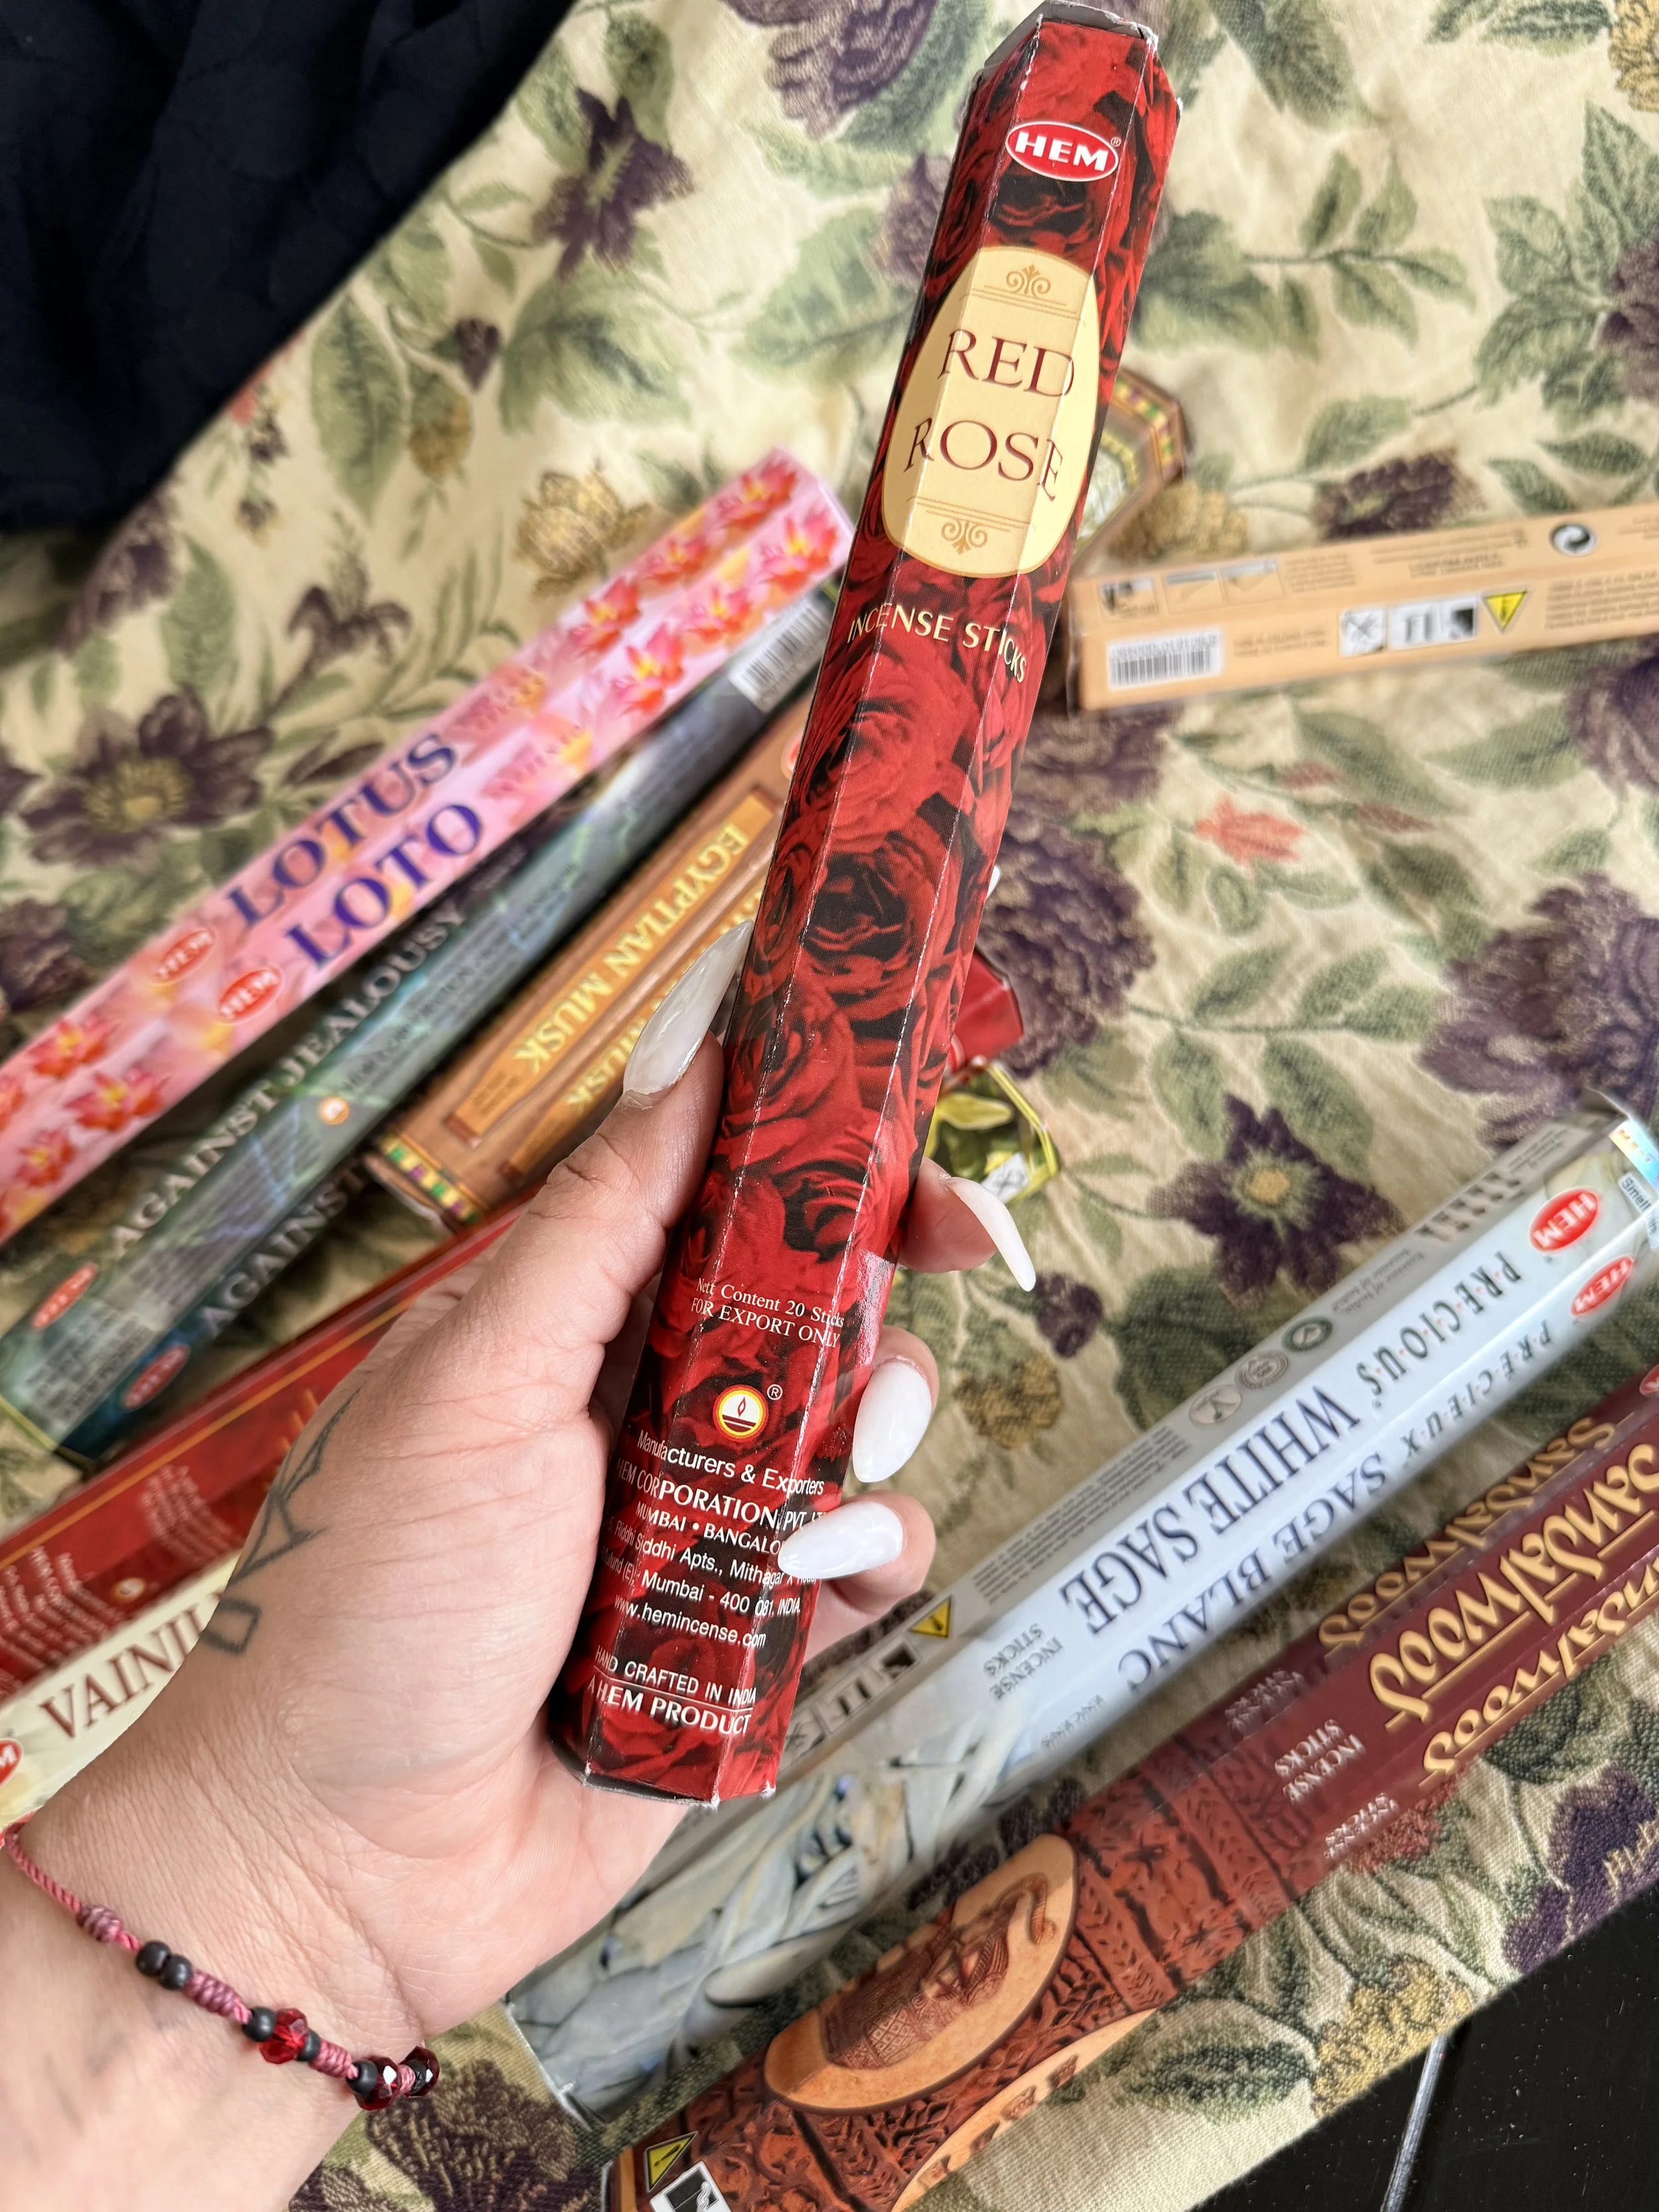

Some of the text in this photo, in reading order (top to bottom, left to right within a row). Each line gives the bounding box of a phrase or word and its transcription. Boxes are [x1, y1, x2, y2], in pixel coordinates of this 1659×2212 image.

[1015, 131, 1108, 171] HEM
[938, 329, 1074, 398] RED
[904, 417, 1063, 502] ROSE
[847, 603, 1027, 683] INCENSE STICKS
[225, 733, 456, 928] LOTUS
[286, 804, 483, 968] LOTO
[603, 822, 749, 977] EGYPTIAN
[514, 972, 613, 1073] MUSK
[110, 1078, 280, 1254] AGAINST
[276, 901, 466, 1088] JEALOUSY
[1533, 1191, 1597, 1249] HEM
[697, 1278, 845, 1328] Nett Content 20 Sticks
[1573, 1259, 1631, 1313] HEM
[691, 1297, 841, 1349] FOR EXPORT ONLY
[637, 1430, 825, 1499] Manufacturers & Exporters
[1183, 1385, 1360, 1535] WHITE
[636, 1501, 687, 1532] MUMBAI
[703, 1522, 781, 1555] BANGALO
[637, 1469, 778, 1528] CORPORATION
[1272, 1452, 1386, 1564] SAGE
[1319, 1416, 1616, 1648] Sandalwood
[614, 1520, 636, 1548] Riddhi
[636, 1532, 677, 1560] Siddhi
[680, 1546, 723, 1577] Apts.,
[730, 1562, 785, 1589] Mithagar
[1060, 1503, 1200, 1635] SAGE
[614, 1594, 766, 1647] www.hemincense.com
[641, 1570, 705, 1602] Mumbai
[720, 1591, 750, 1613] 400
[1118, 1548, 1271, 1694] BLANC
[595, 1645, 757, 1705] HAND CRAFTED IN INDIA
[983, 1623, 1043, 1676] STICKS
[989, 1636, 1063, 1700] INCENSE
[1423, 1556, 1659, 1776] ndalwood
[588, 1674, 752, 1734] A HEM PRODUCT
[1275, 1719, 1343, 1779] STICKS
[1283, 1733, 1365, 1804] INCENSE
